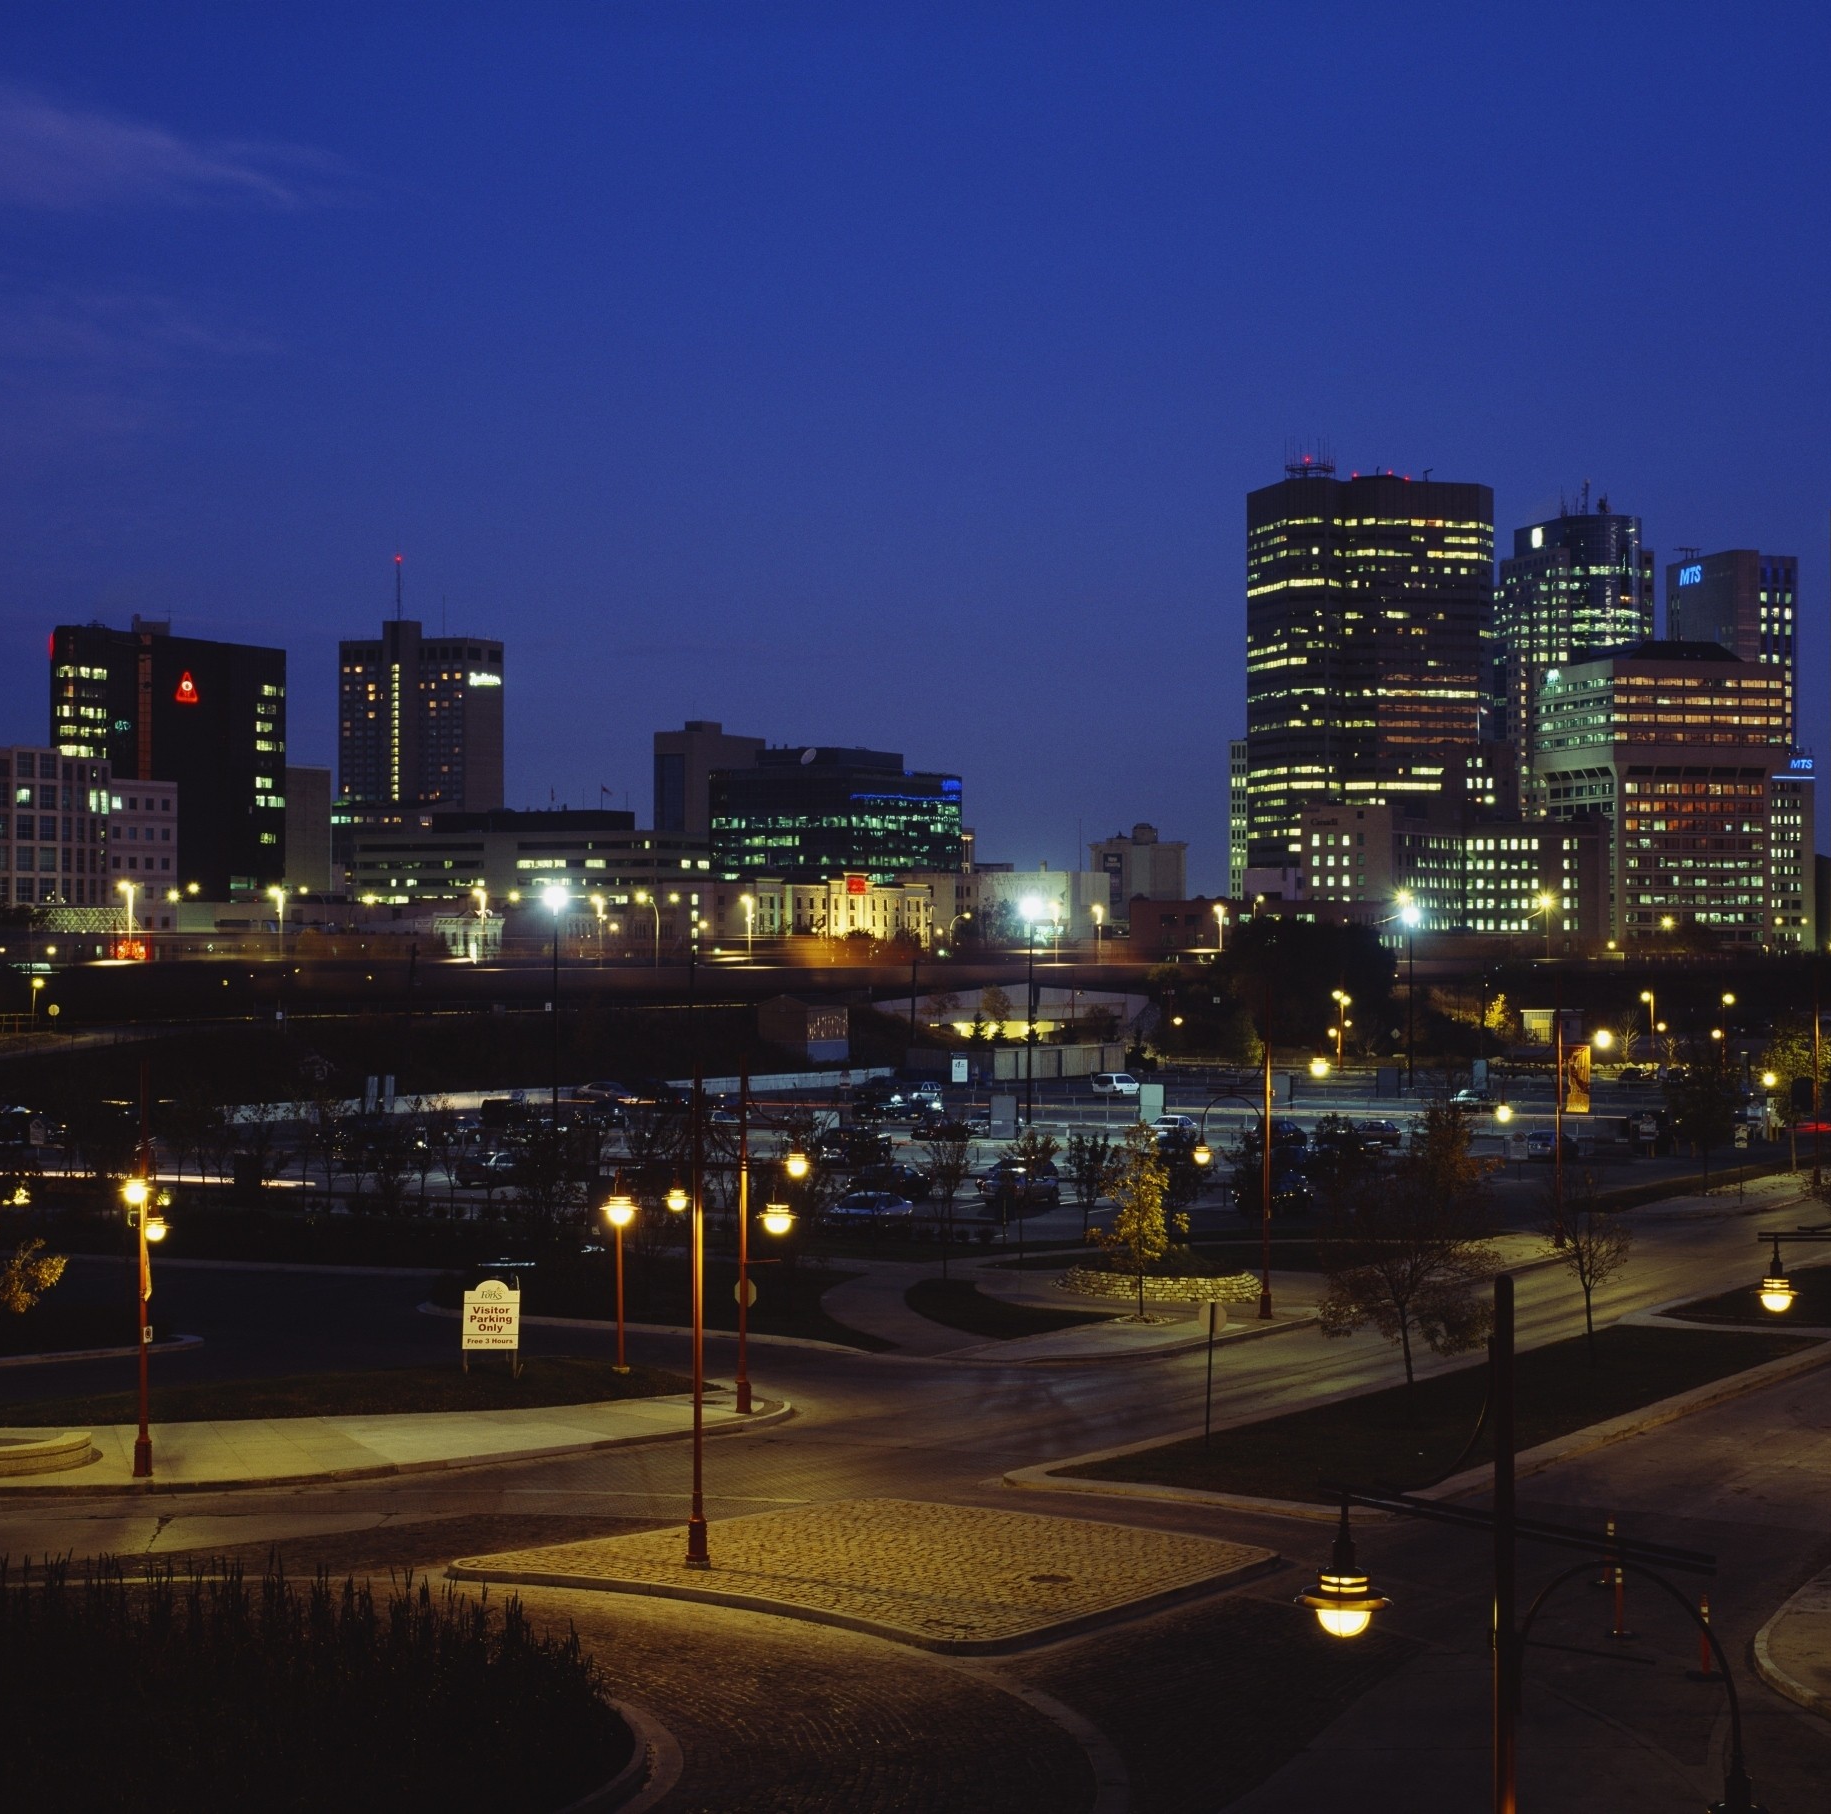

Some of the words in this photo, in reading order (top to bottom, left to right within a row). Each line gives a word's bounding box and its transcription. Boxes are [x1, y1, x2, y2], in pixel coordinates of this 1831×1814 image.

[1679, 565, 1702, 587] MTS
[1790, 759, 1813, 769] MTS
[1311, 818, 1338, 826] Canada
[473, 1306, 510, 1314] Visitor
[470, 1315, 512, 1324] Parking
[478, 1323, 503, 1333] Only
